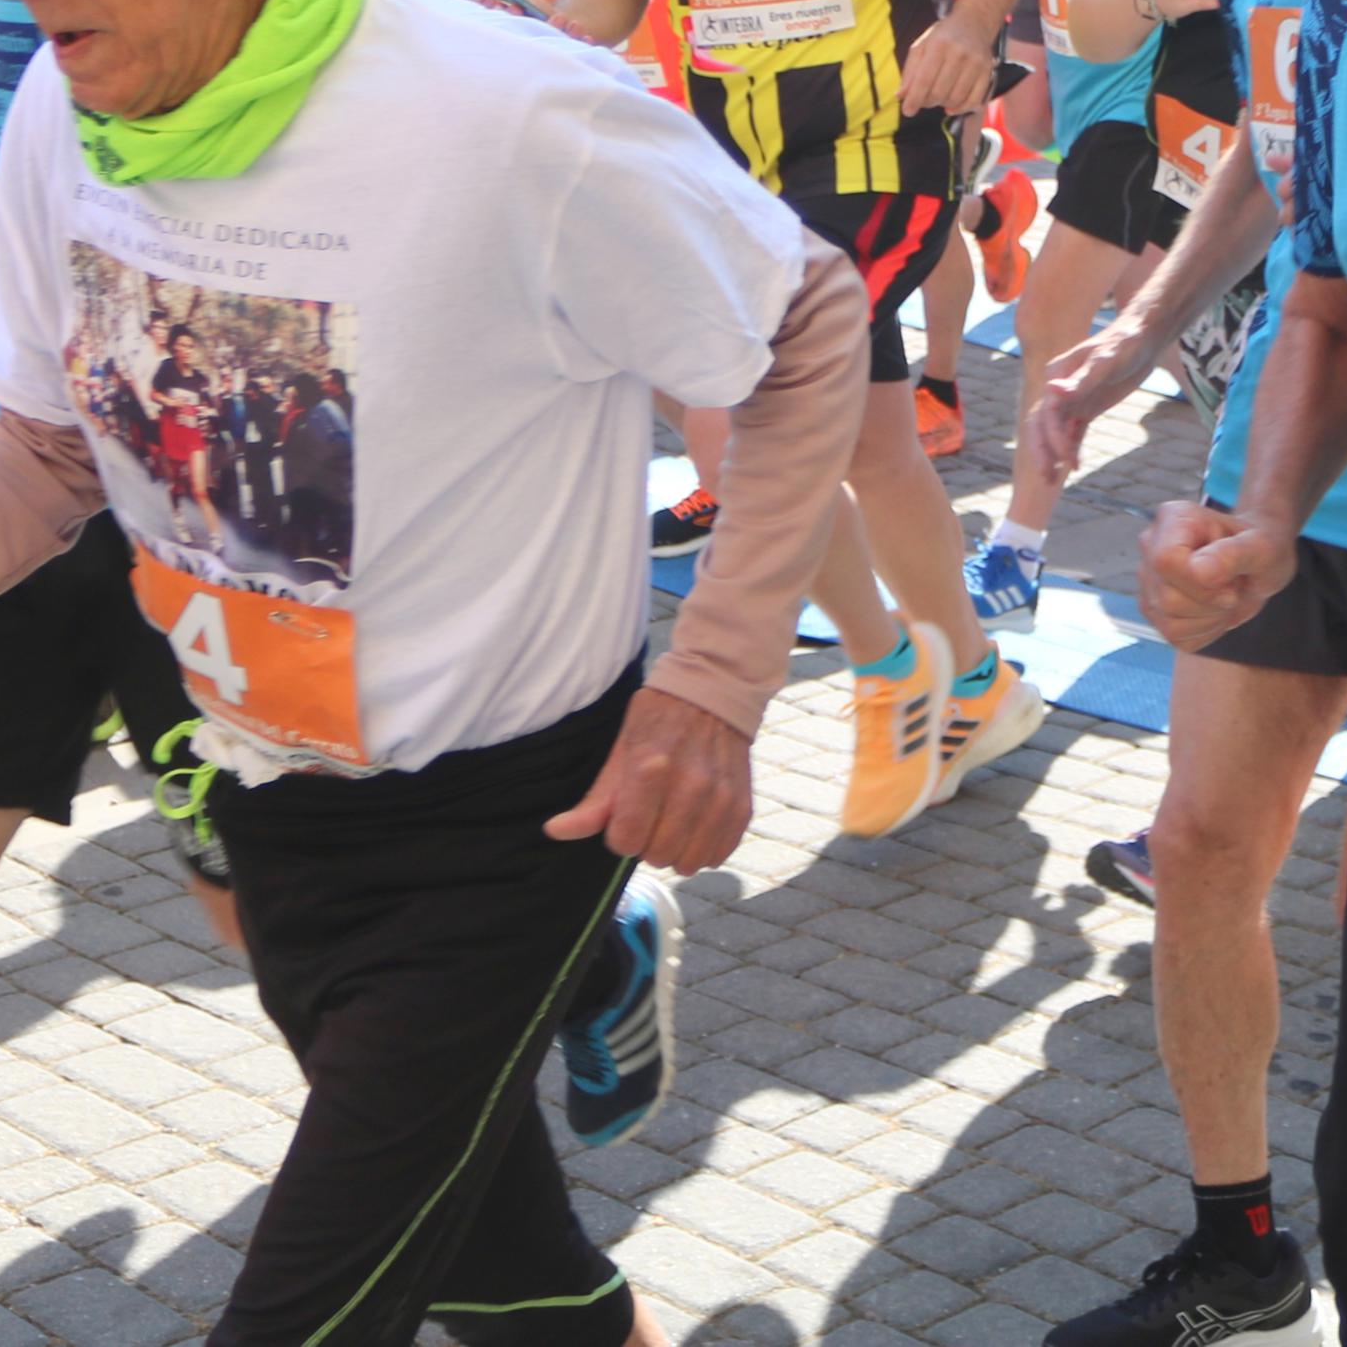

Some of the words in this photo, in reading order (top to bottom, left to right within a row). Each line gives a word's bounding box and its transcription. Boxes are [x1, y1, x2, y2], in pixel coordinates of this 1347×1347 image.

[719, 15, 764, 34] INTEGRA
[769, 11, 793, 22] Eres
[795, 4, 842, 20] nuestra
[212, 223, 351, 253] DEDICADA
[137, 239, 226, 275] MEMORIA
[233, 259, 269, 281] DE
[167, 591, 249, 707] 4
